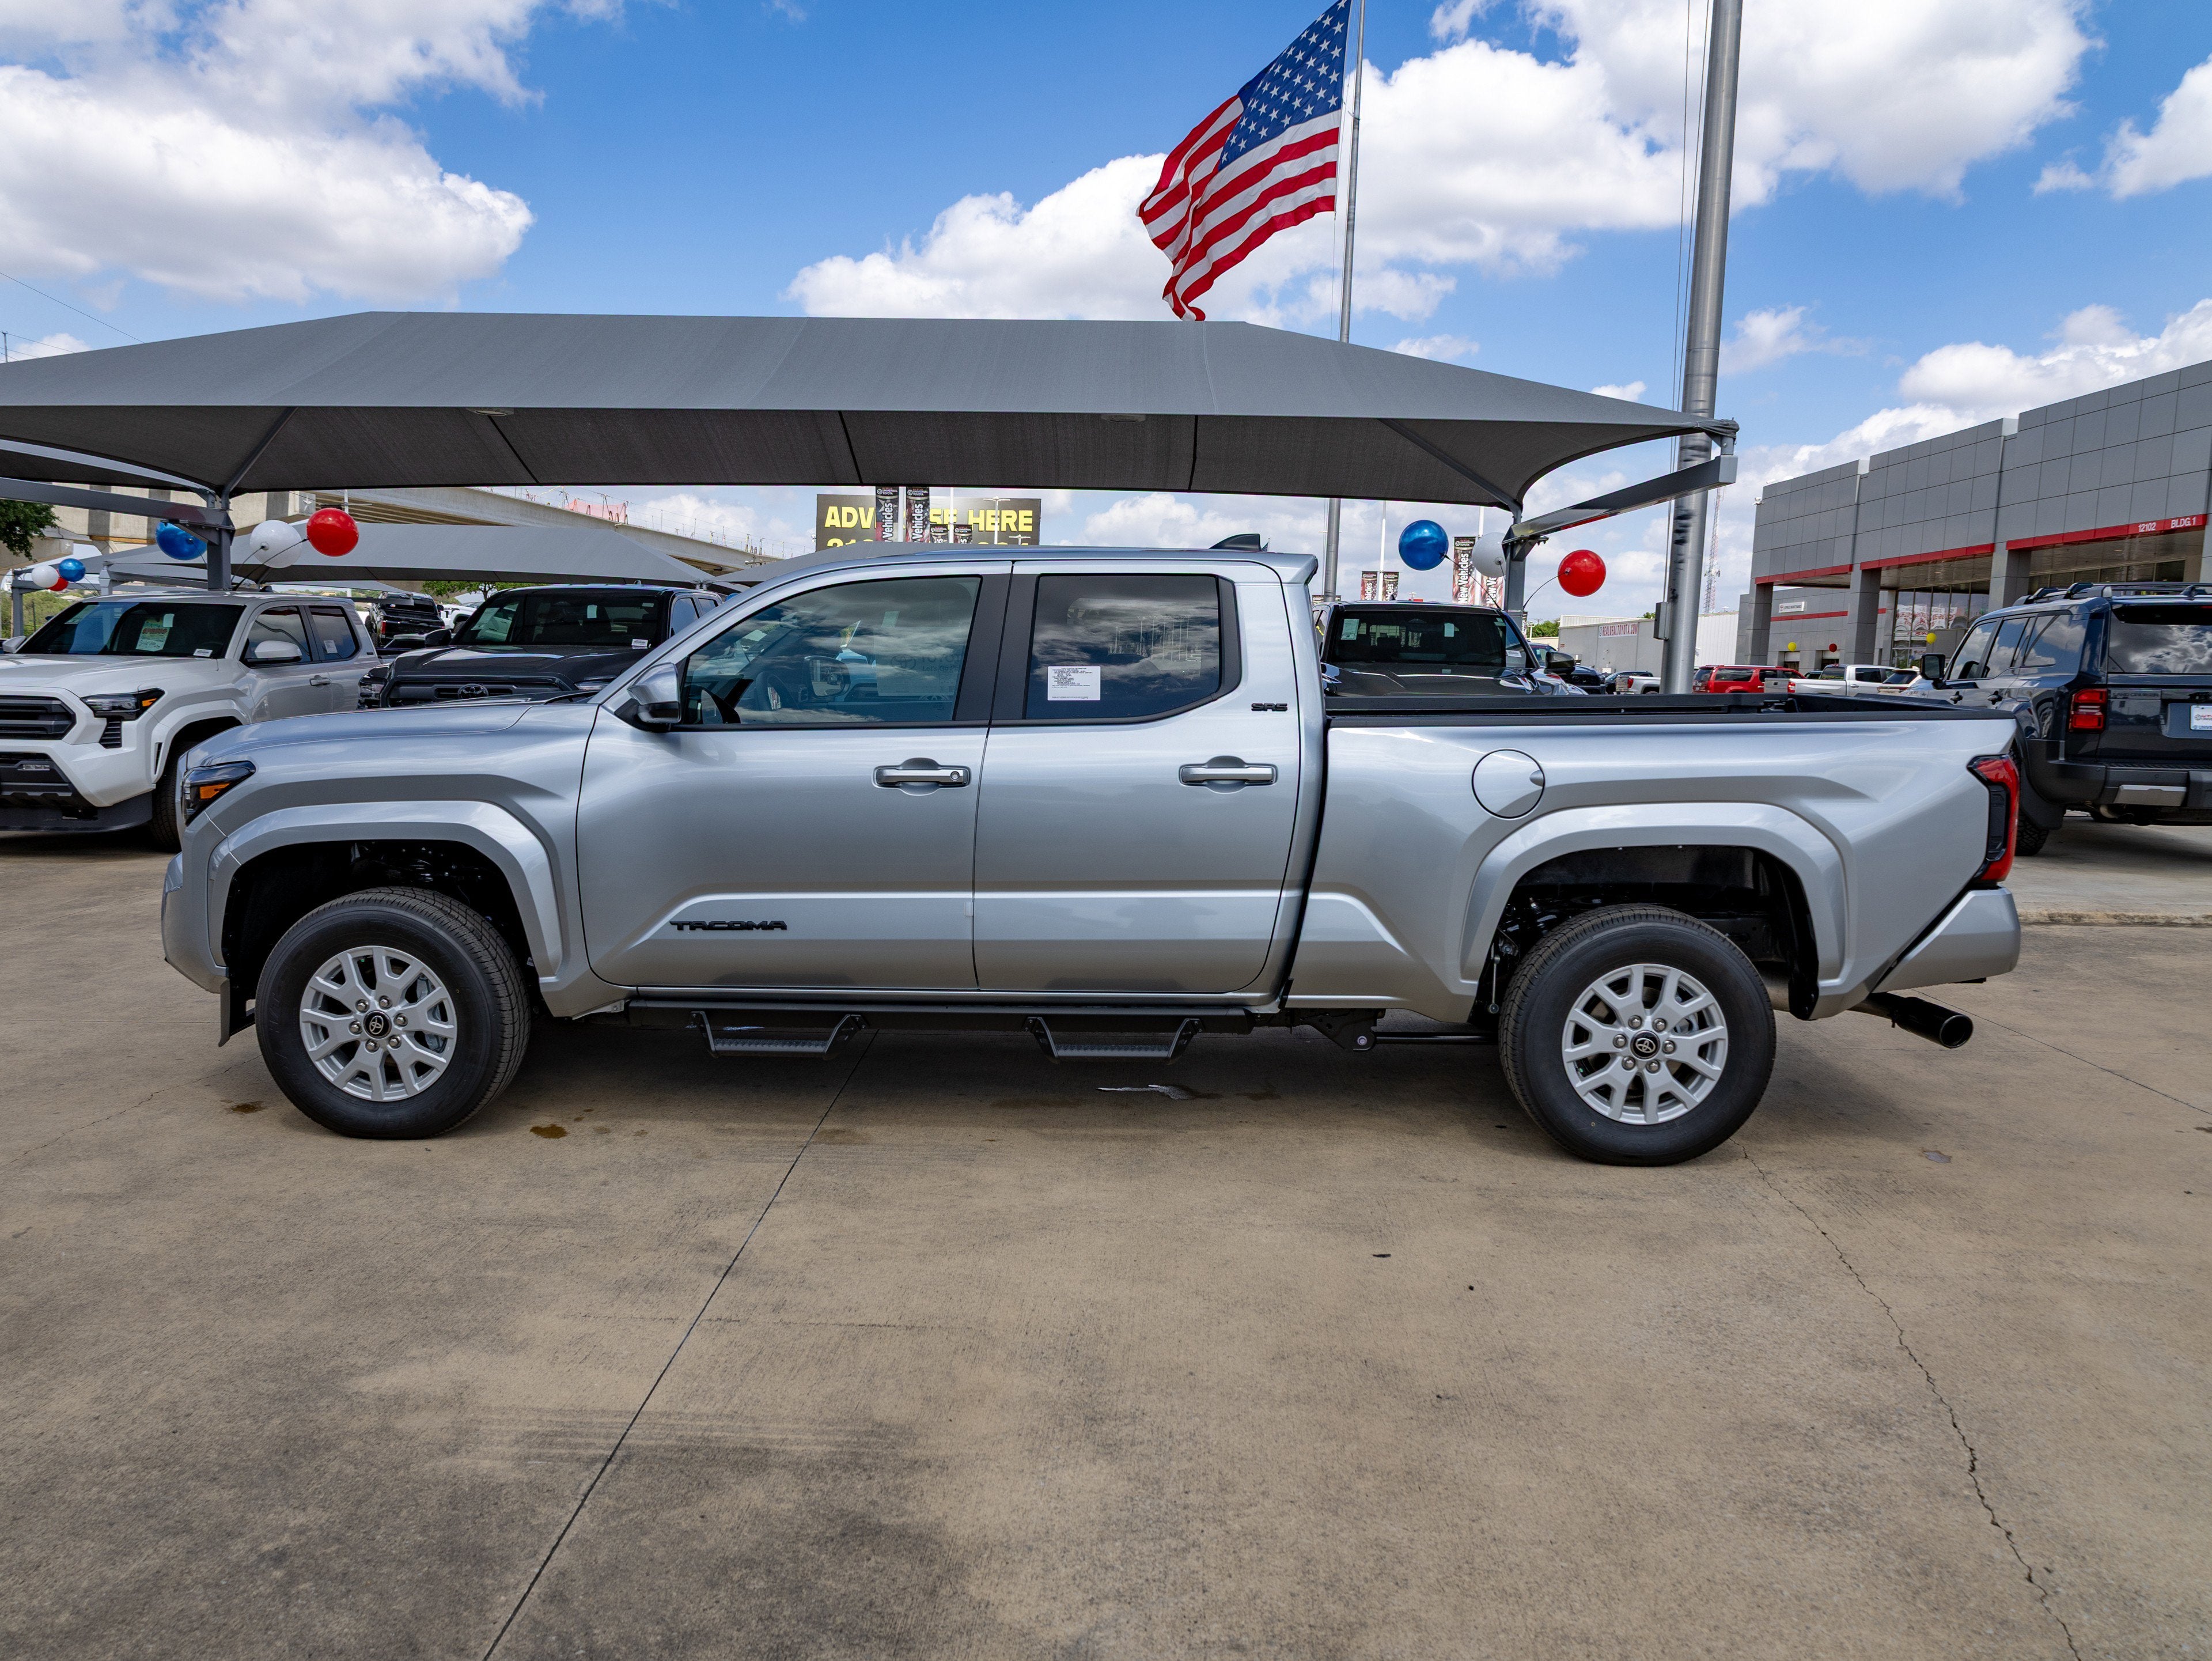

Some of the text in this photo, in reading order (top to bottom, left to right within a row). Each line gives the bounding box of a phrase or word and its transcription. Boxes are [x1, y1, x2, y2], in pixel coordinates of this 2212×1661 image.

[824, 506, 1033, 532] ADVSE HERE
[882, 502, 893, 539] Vehicles
[912, 503, 923, 542] Vehicles
[2138, 522, 2157, 532] 12102
[1458, 553, 1469, 587] Vehicles
[1458, 587, 1468, 604] New
[1486, 587, 1497, 604] New
[1251, 702, 1288, 712] SR5
[669, 920, 787, 930] TACOMA
